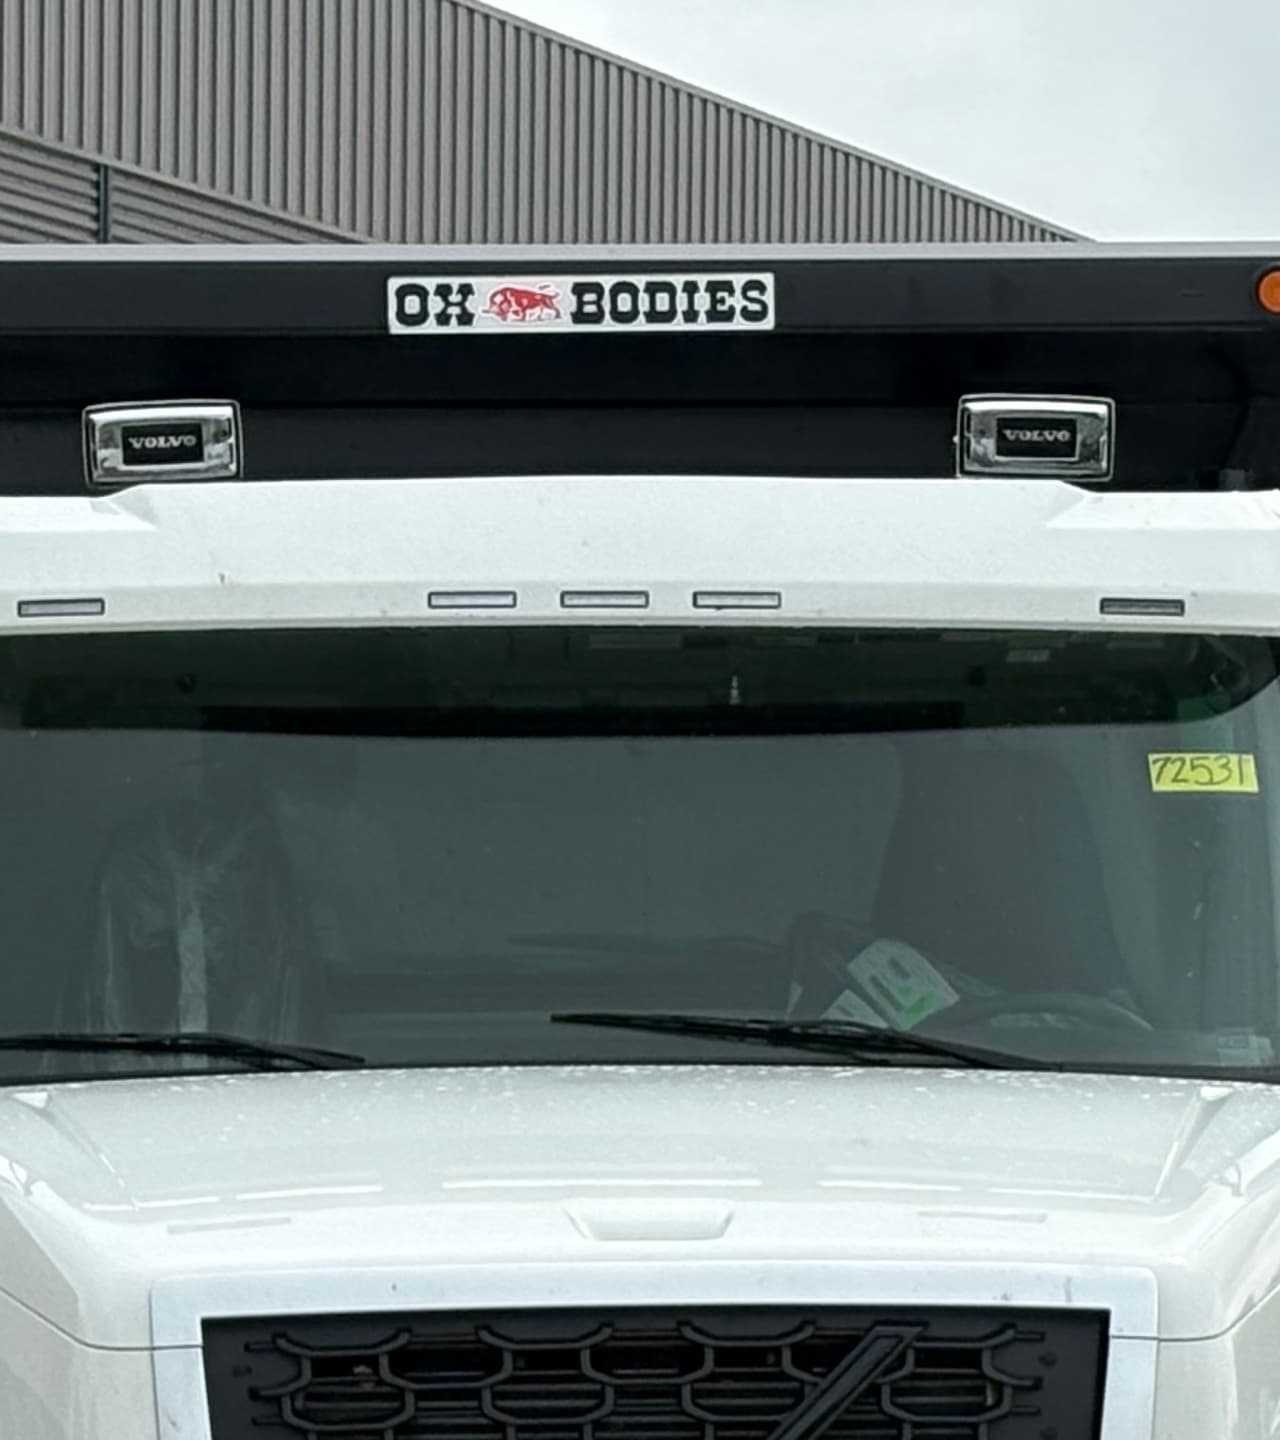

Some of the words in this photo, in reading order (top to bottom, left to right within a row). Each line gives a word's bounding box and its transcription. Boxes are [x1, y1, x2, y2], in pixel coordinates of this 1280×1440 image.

[394, 283, 476, 326] OX
[571, 279, 769, 324] BODIES
[127, 434, 197, 450] VOLVO
[1001, 428, 1070, 442] VOLVO
[1151, 755, 1244, 786] 72531
